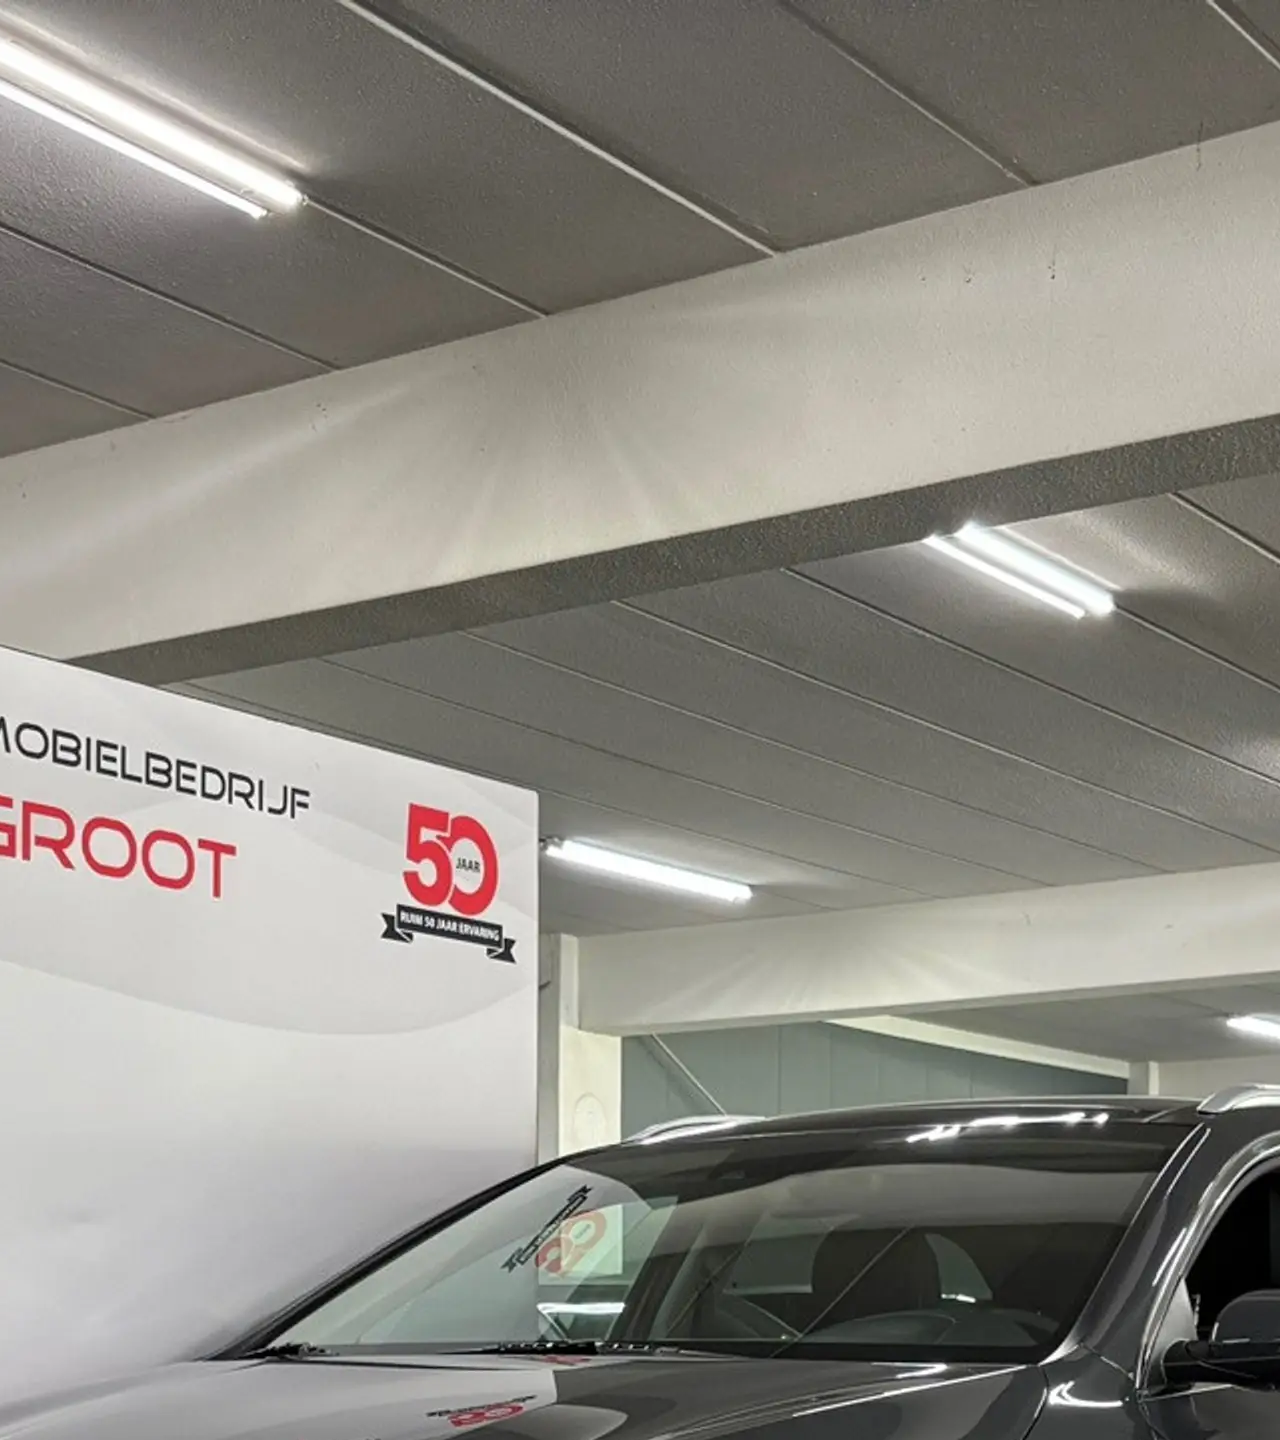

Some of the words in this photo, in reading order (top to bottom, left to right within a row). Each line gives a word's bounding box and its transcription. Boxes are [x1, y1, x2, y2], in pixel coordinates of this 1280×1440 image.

[402, 803, 500, 918] 50
[455, 857, 481, 874] JAAR
[400, 910, 424, 926] RUIM
[424, 915, 436, 929] 50
[436, 917, 458, 933] JAAR
[458, 922, 500, 941] ERVARING
